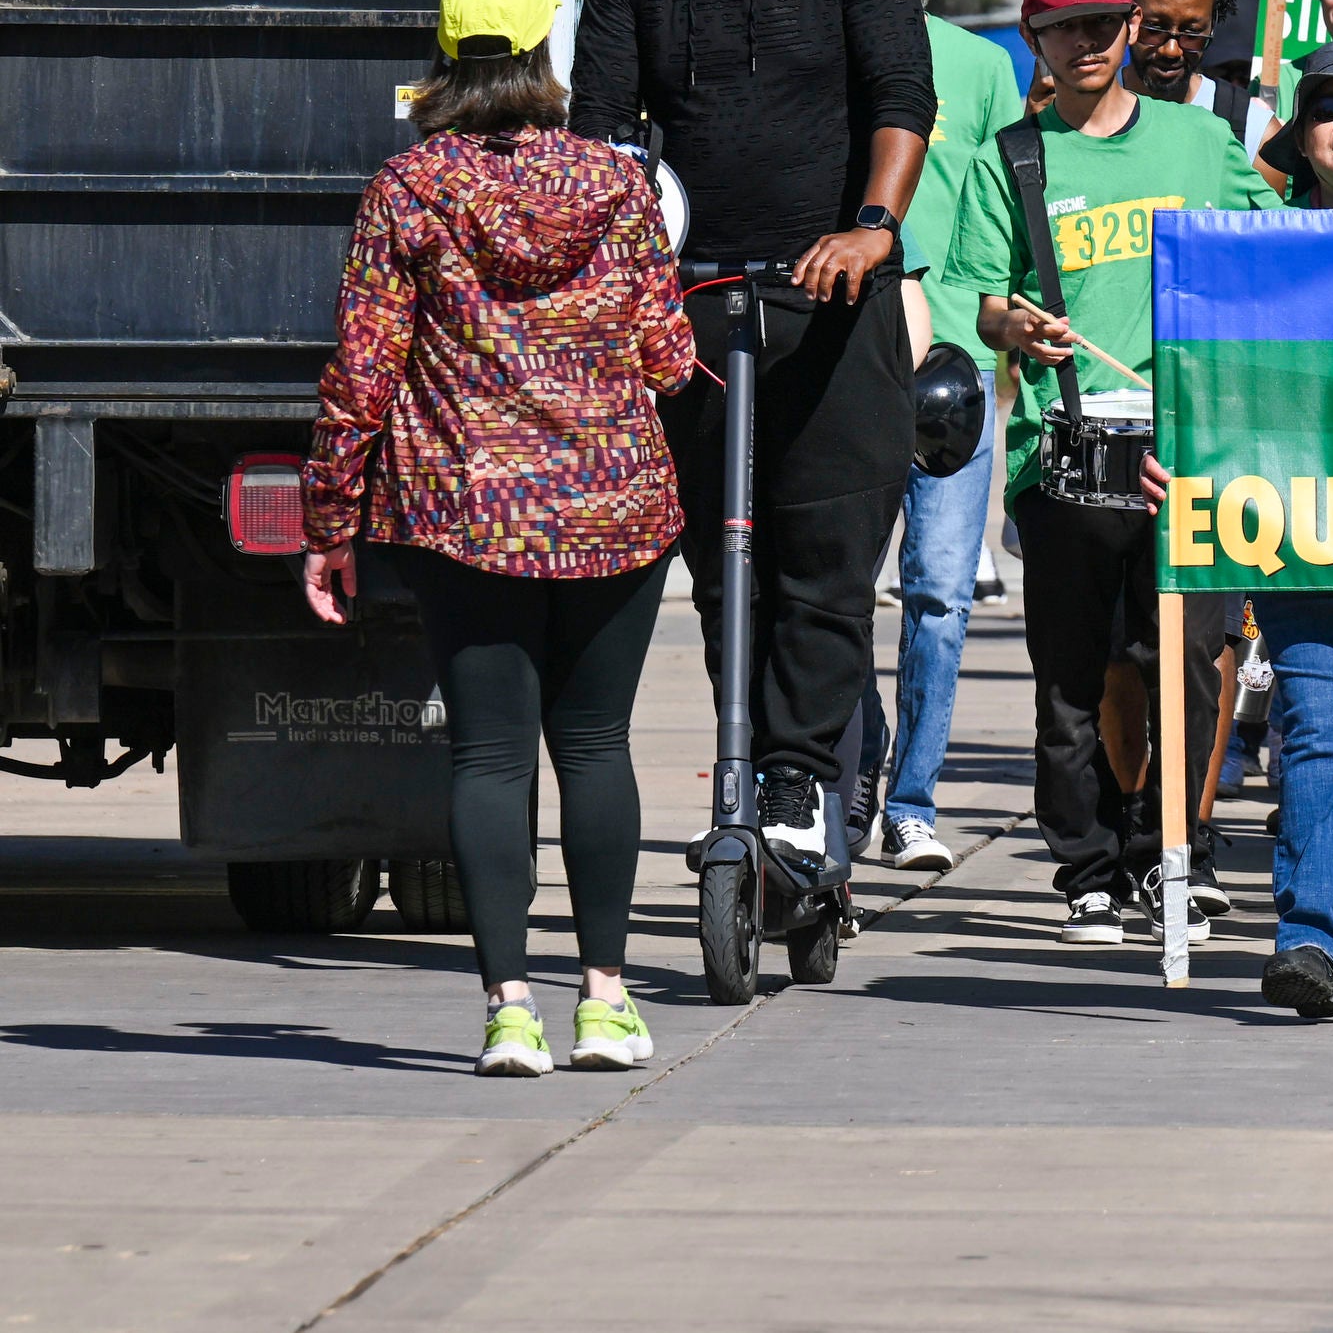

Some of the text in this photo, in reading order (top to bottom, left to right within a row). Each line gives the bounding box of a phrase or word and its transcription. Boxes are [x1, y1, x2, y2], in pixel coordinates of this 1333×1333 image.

[1046, 195, 1087, 218] AFSCME
[1074, 207, 1151, 261] 329
[255, 691, 446, 727] Marathon
